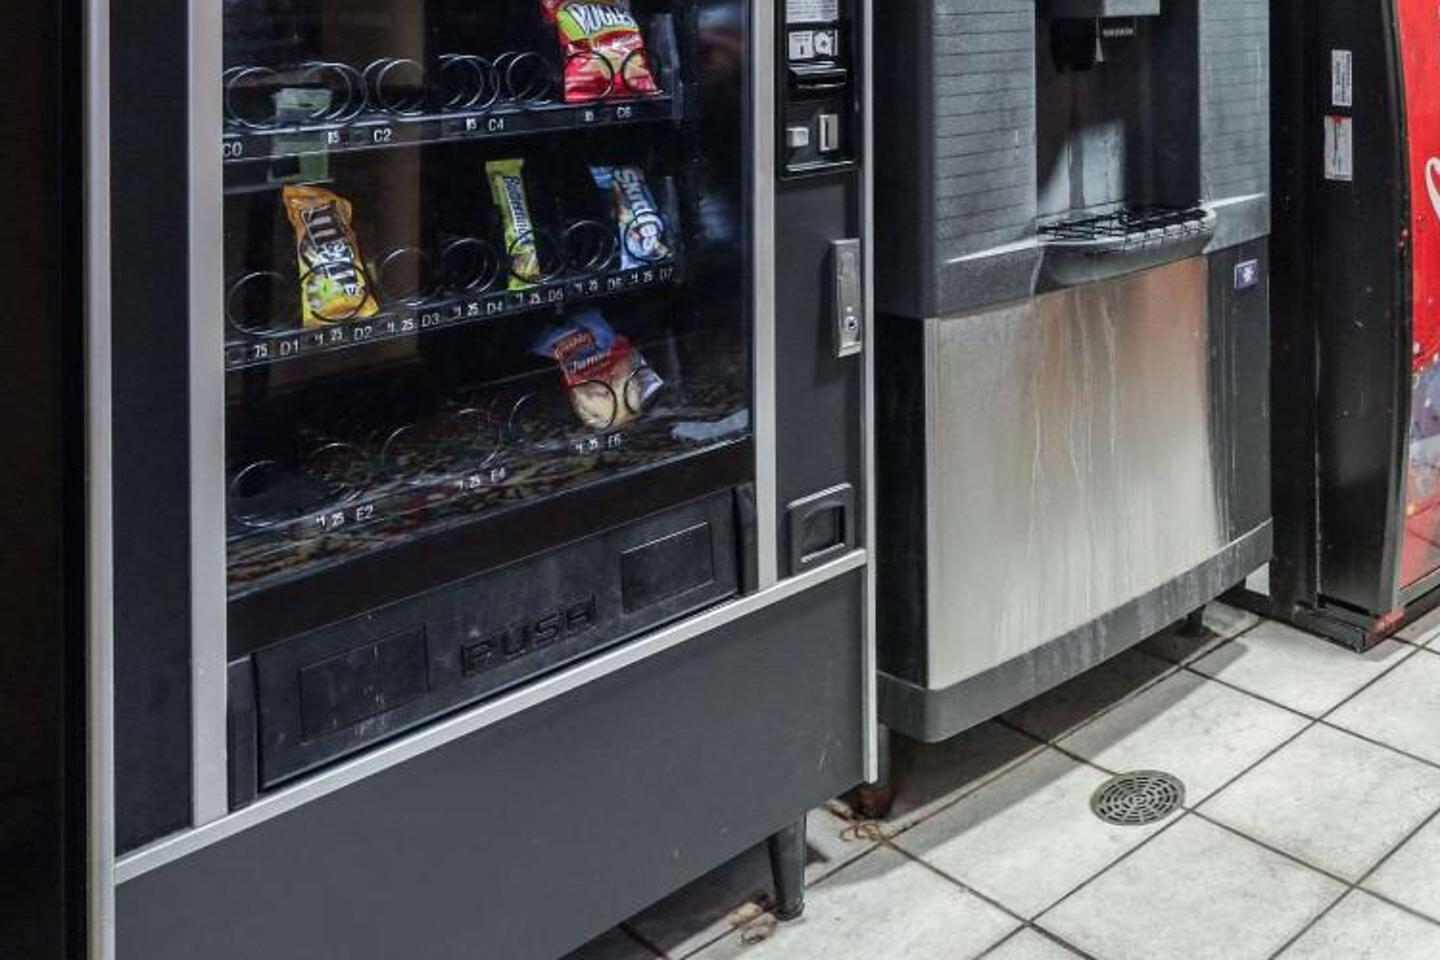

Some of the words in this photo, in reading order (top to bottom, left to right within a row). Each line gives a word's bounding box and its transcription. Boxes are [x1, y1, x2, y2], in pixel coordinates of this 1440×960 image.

[373, 128, 392, 143] C2
[421, 314, 440, 328] D3
[354, 325, 373, 340] D2
[280, 340, 299, 356] D1
[460, 592, 597, 679] PUSH
